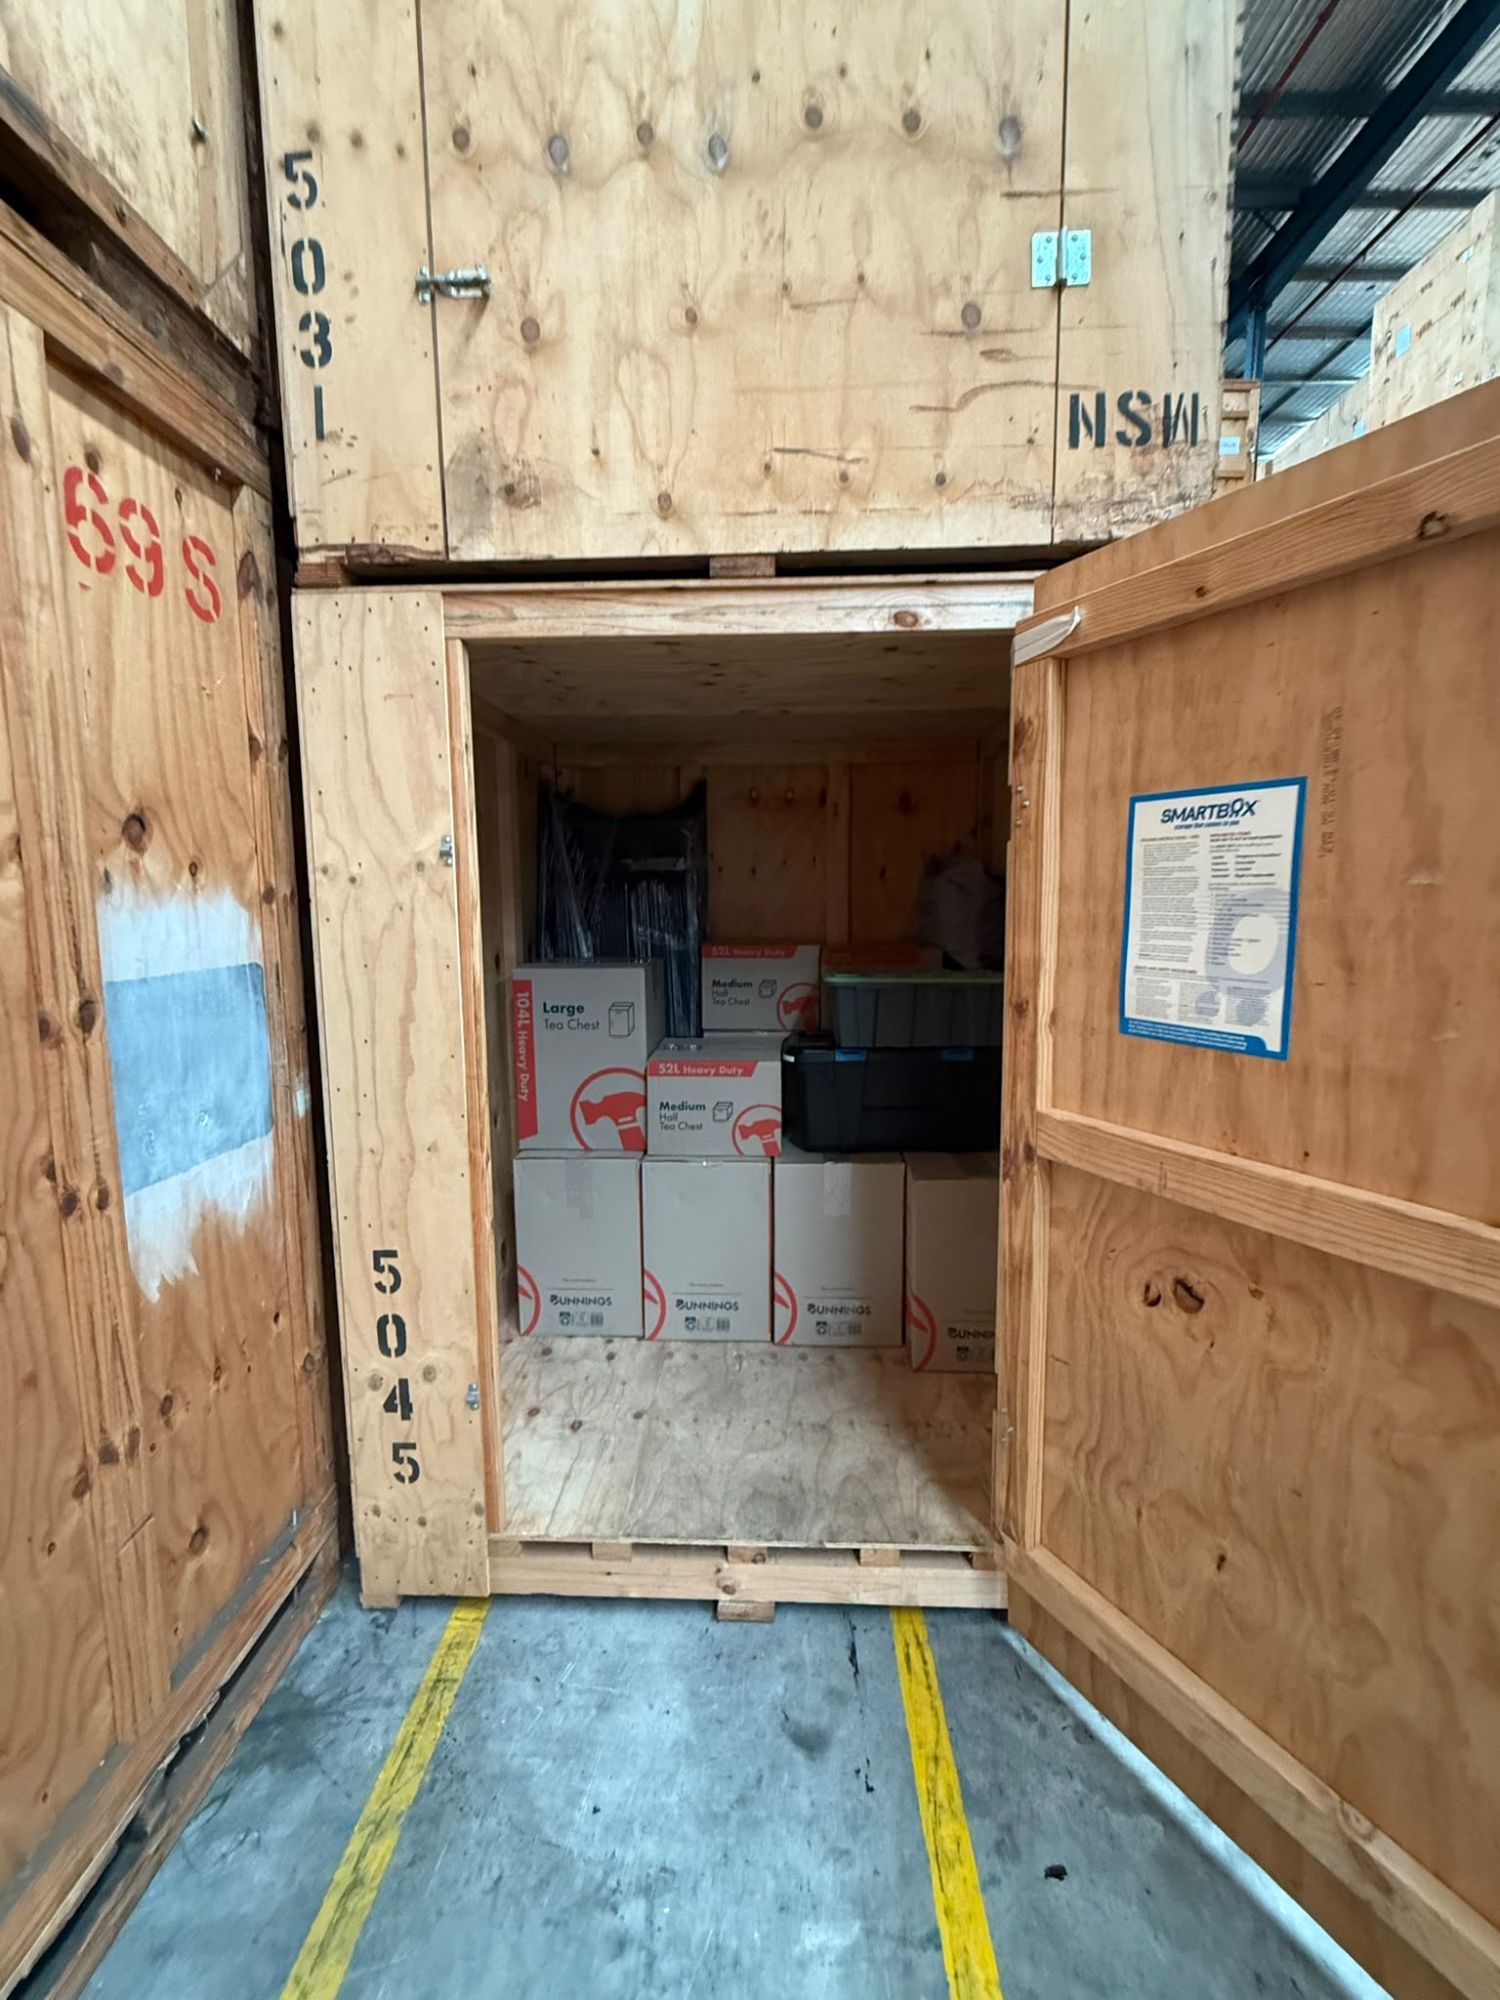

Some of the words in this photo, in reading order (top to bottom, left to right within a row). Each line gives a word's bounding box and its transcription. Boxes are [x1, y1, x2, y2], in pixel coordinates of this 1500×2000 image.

[1068, 391, 1199, 449] NSW
[1161, 798, 1258, 823] SMARTBOX
[712, 978, 753, 988] Medium
[516, 991, 530, 1026] 104L
[543, 1001, 585, 1017] Large
[544, 1018, 563, 1030] Tea
[567, 1018, 600, 1030] Chest
[517, 1031, 528, 1070] Heavy
[659, 1063, 680, 1074] 52L
[683, 1065, 715, 1075] Heavy
[719, 1065, 744, 1075] Duty
[518, 1073, 530, 1101] Duty
[659, 1101, 706, 1111] Medium
[660, 1121, 675, 1131] Tea
[678, 1121, 703, 1131] Chest
[550, 1294, 612, 1307] BUNNINGS
[675, 1299, 739, 1312] BUNNINGS
[807, 1303, 872, 1316] BUNNINGS
[947, 1327, 995, 1339] BUNNIN
[372, 1250, 420, 1484] 5045
